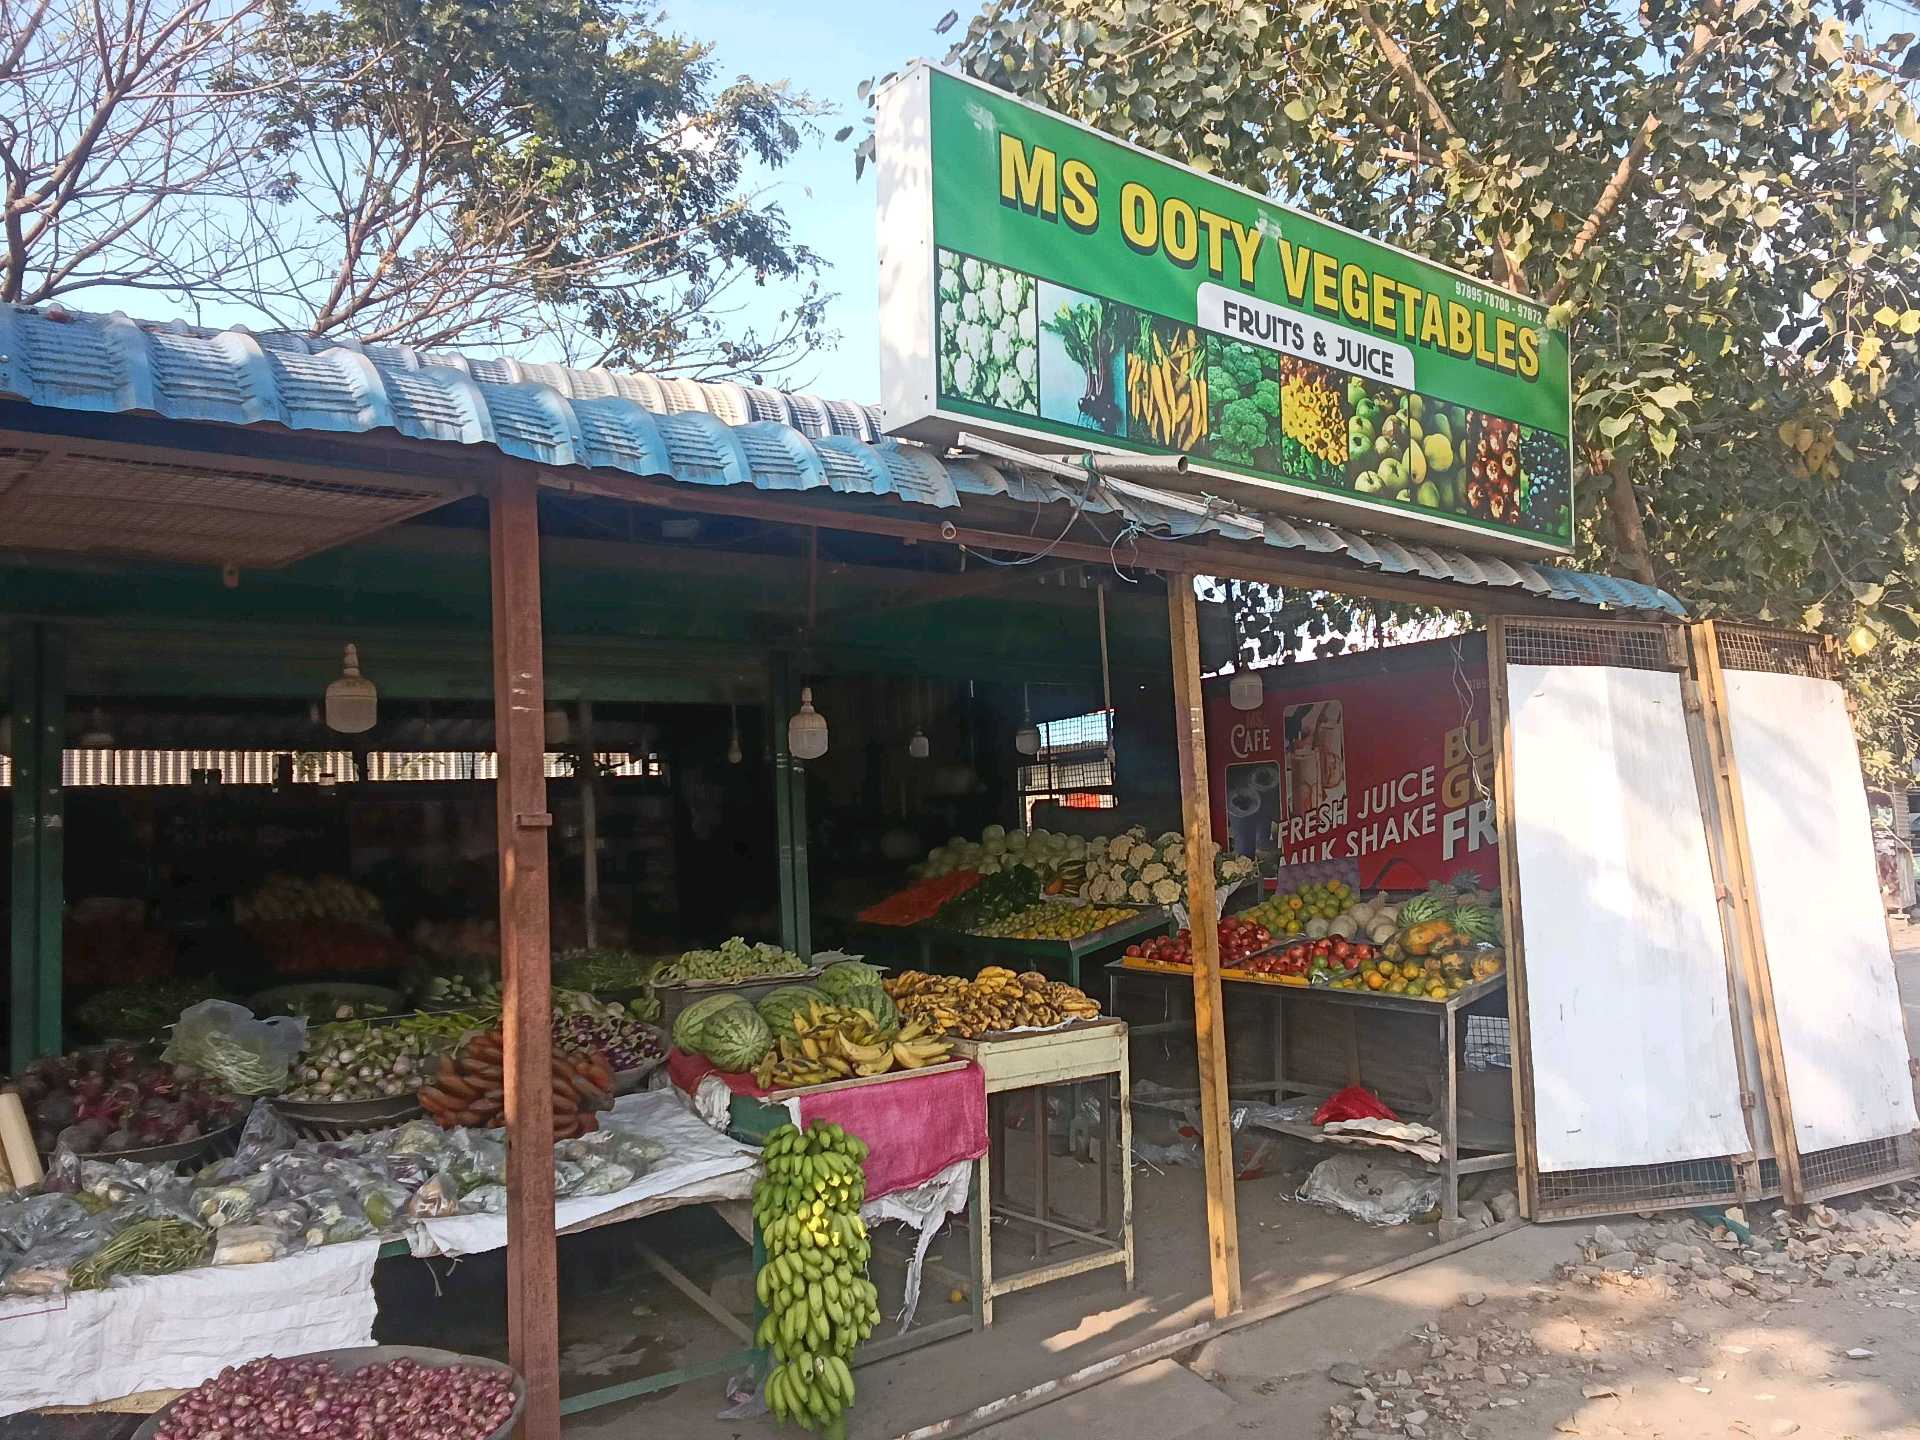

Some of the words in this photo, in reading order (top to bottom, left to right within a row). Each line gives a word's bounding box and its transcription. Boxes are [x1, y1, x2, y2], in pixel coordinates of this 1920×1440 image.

[1000, 132, 1099, 234] MS
[1119, 181, 1263, 289] OOTY
[1278, 238, 1542, 383] VEGETABLES
[1455, 281, 1482, 303] 97895
[1224, 300, 1304, 351] FRUITS
[1313, 331, 1327, 357] &
[1336, 337, 1394, 378] JUICE
[1278, 798, 1348, 848] FRESH
[1357, 765, 1435, 819] JUICE
[1346, 802, 1436, 857] SHAKE
